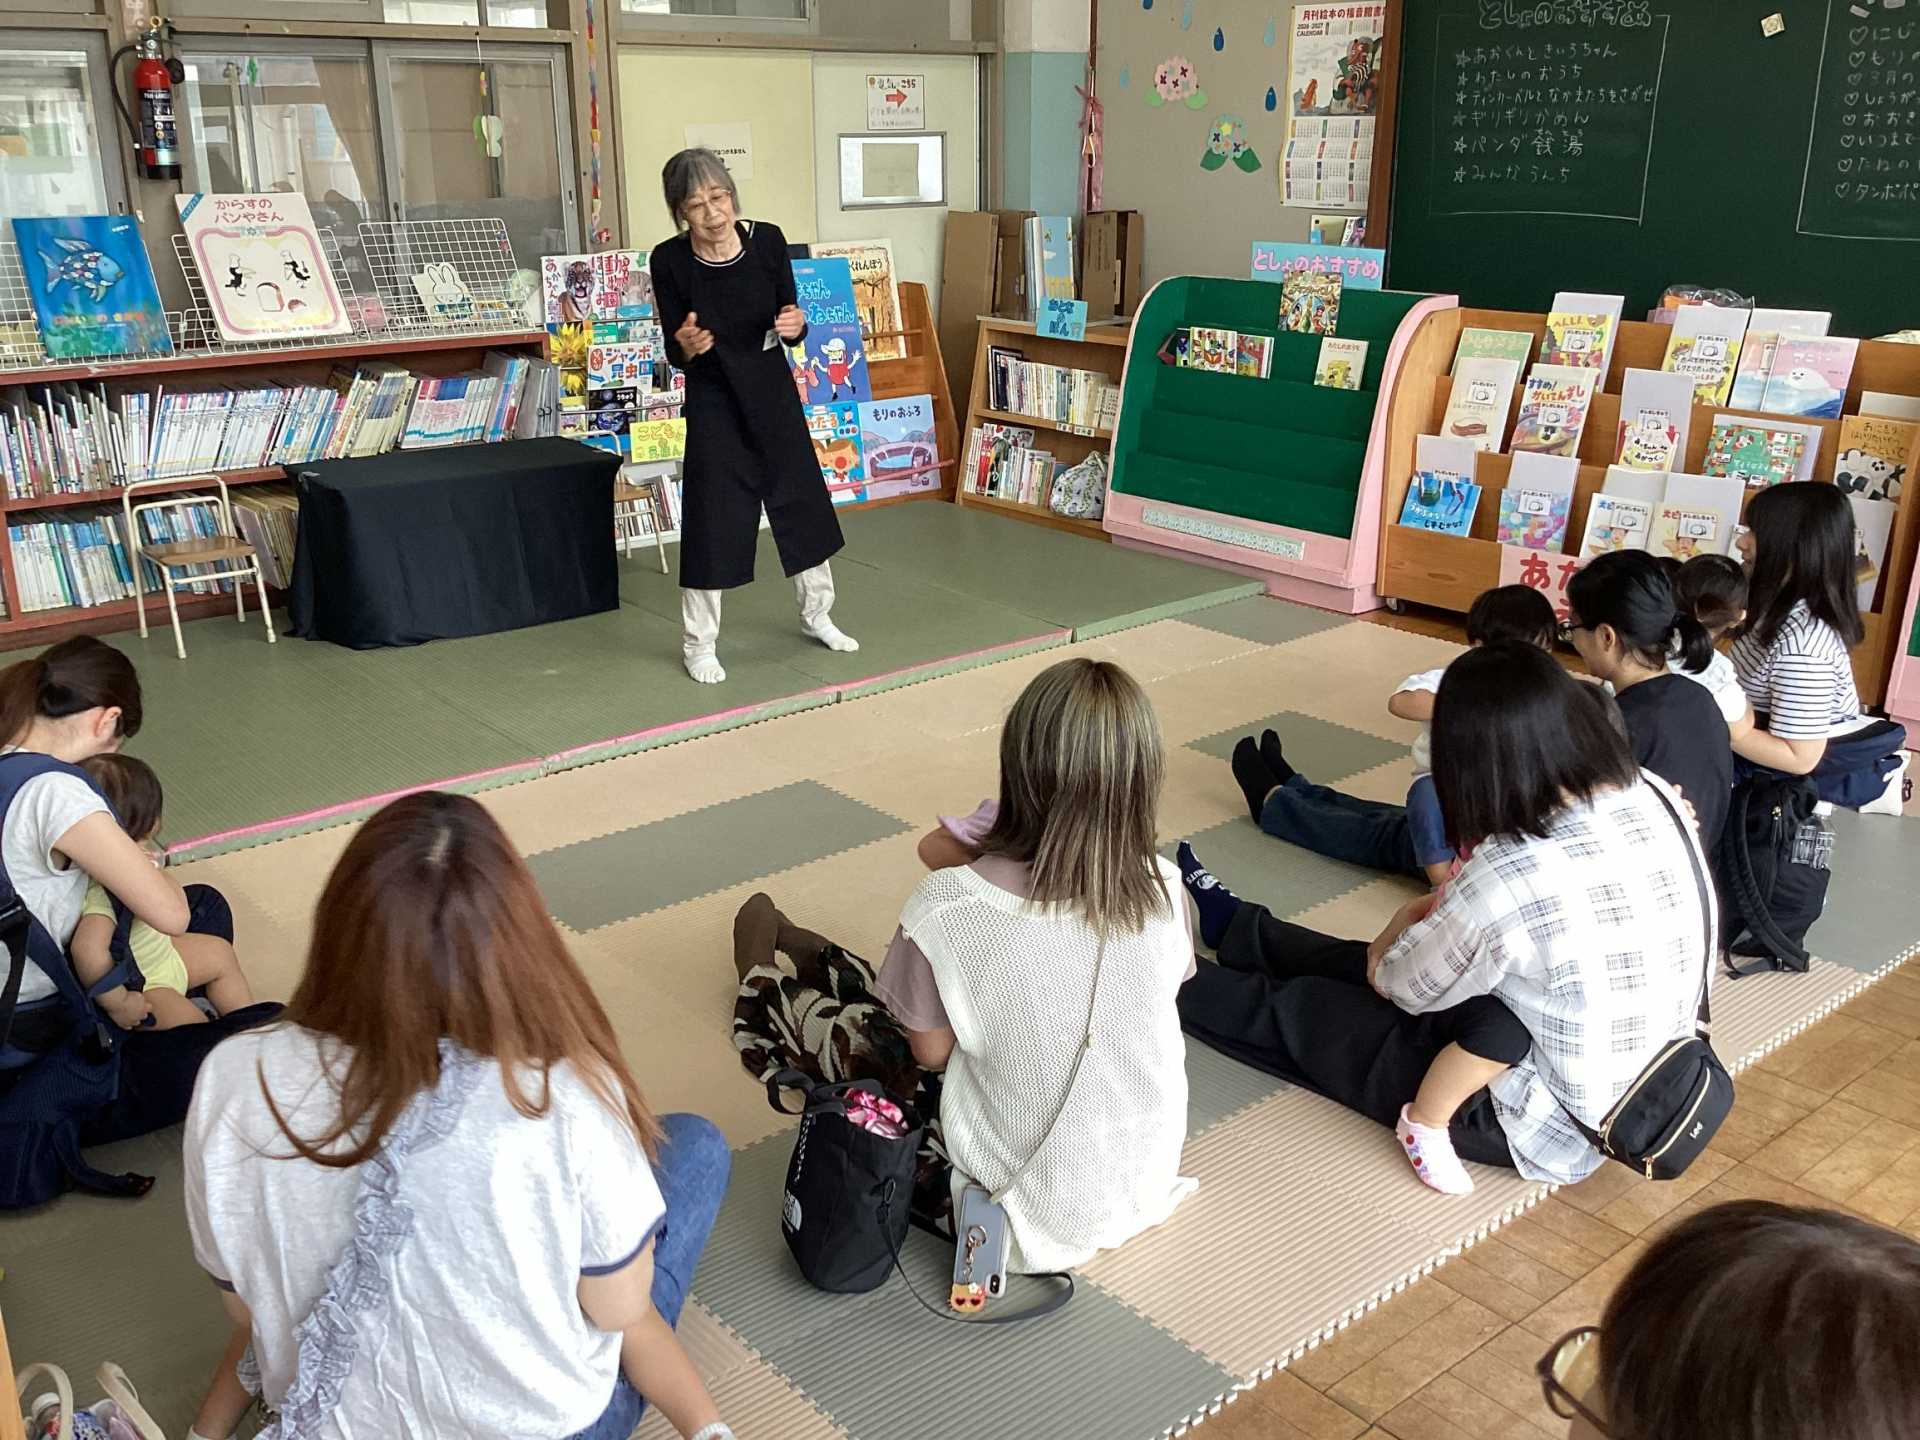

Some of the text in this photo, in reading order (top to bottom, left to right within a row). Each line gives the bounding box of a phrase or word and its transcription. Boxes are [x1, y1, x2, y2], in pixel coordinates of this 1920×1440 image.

[1303, 6, 1385, 20] 月刊絵本の福音館書
[1872, 22, 1916, 40] にじ
[1865, 90, 1920, 105] しょうが
[1857, 157, 1920, 172] たねの
[214, 199, 273, 210] からすの
[214, 211, 284, 223] パンやさん
[849, 259, 883, 272] くれんぼう
[1253, 249, 1380, 280] としょのおすすめ
[605, 344, 653, 364] ジャンボ
[873, 405, 921, 421] もりのおふろ
